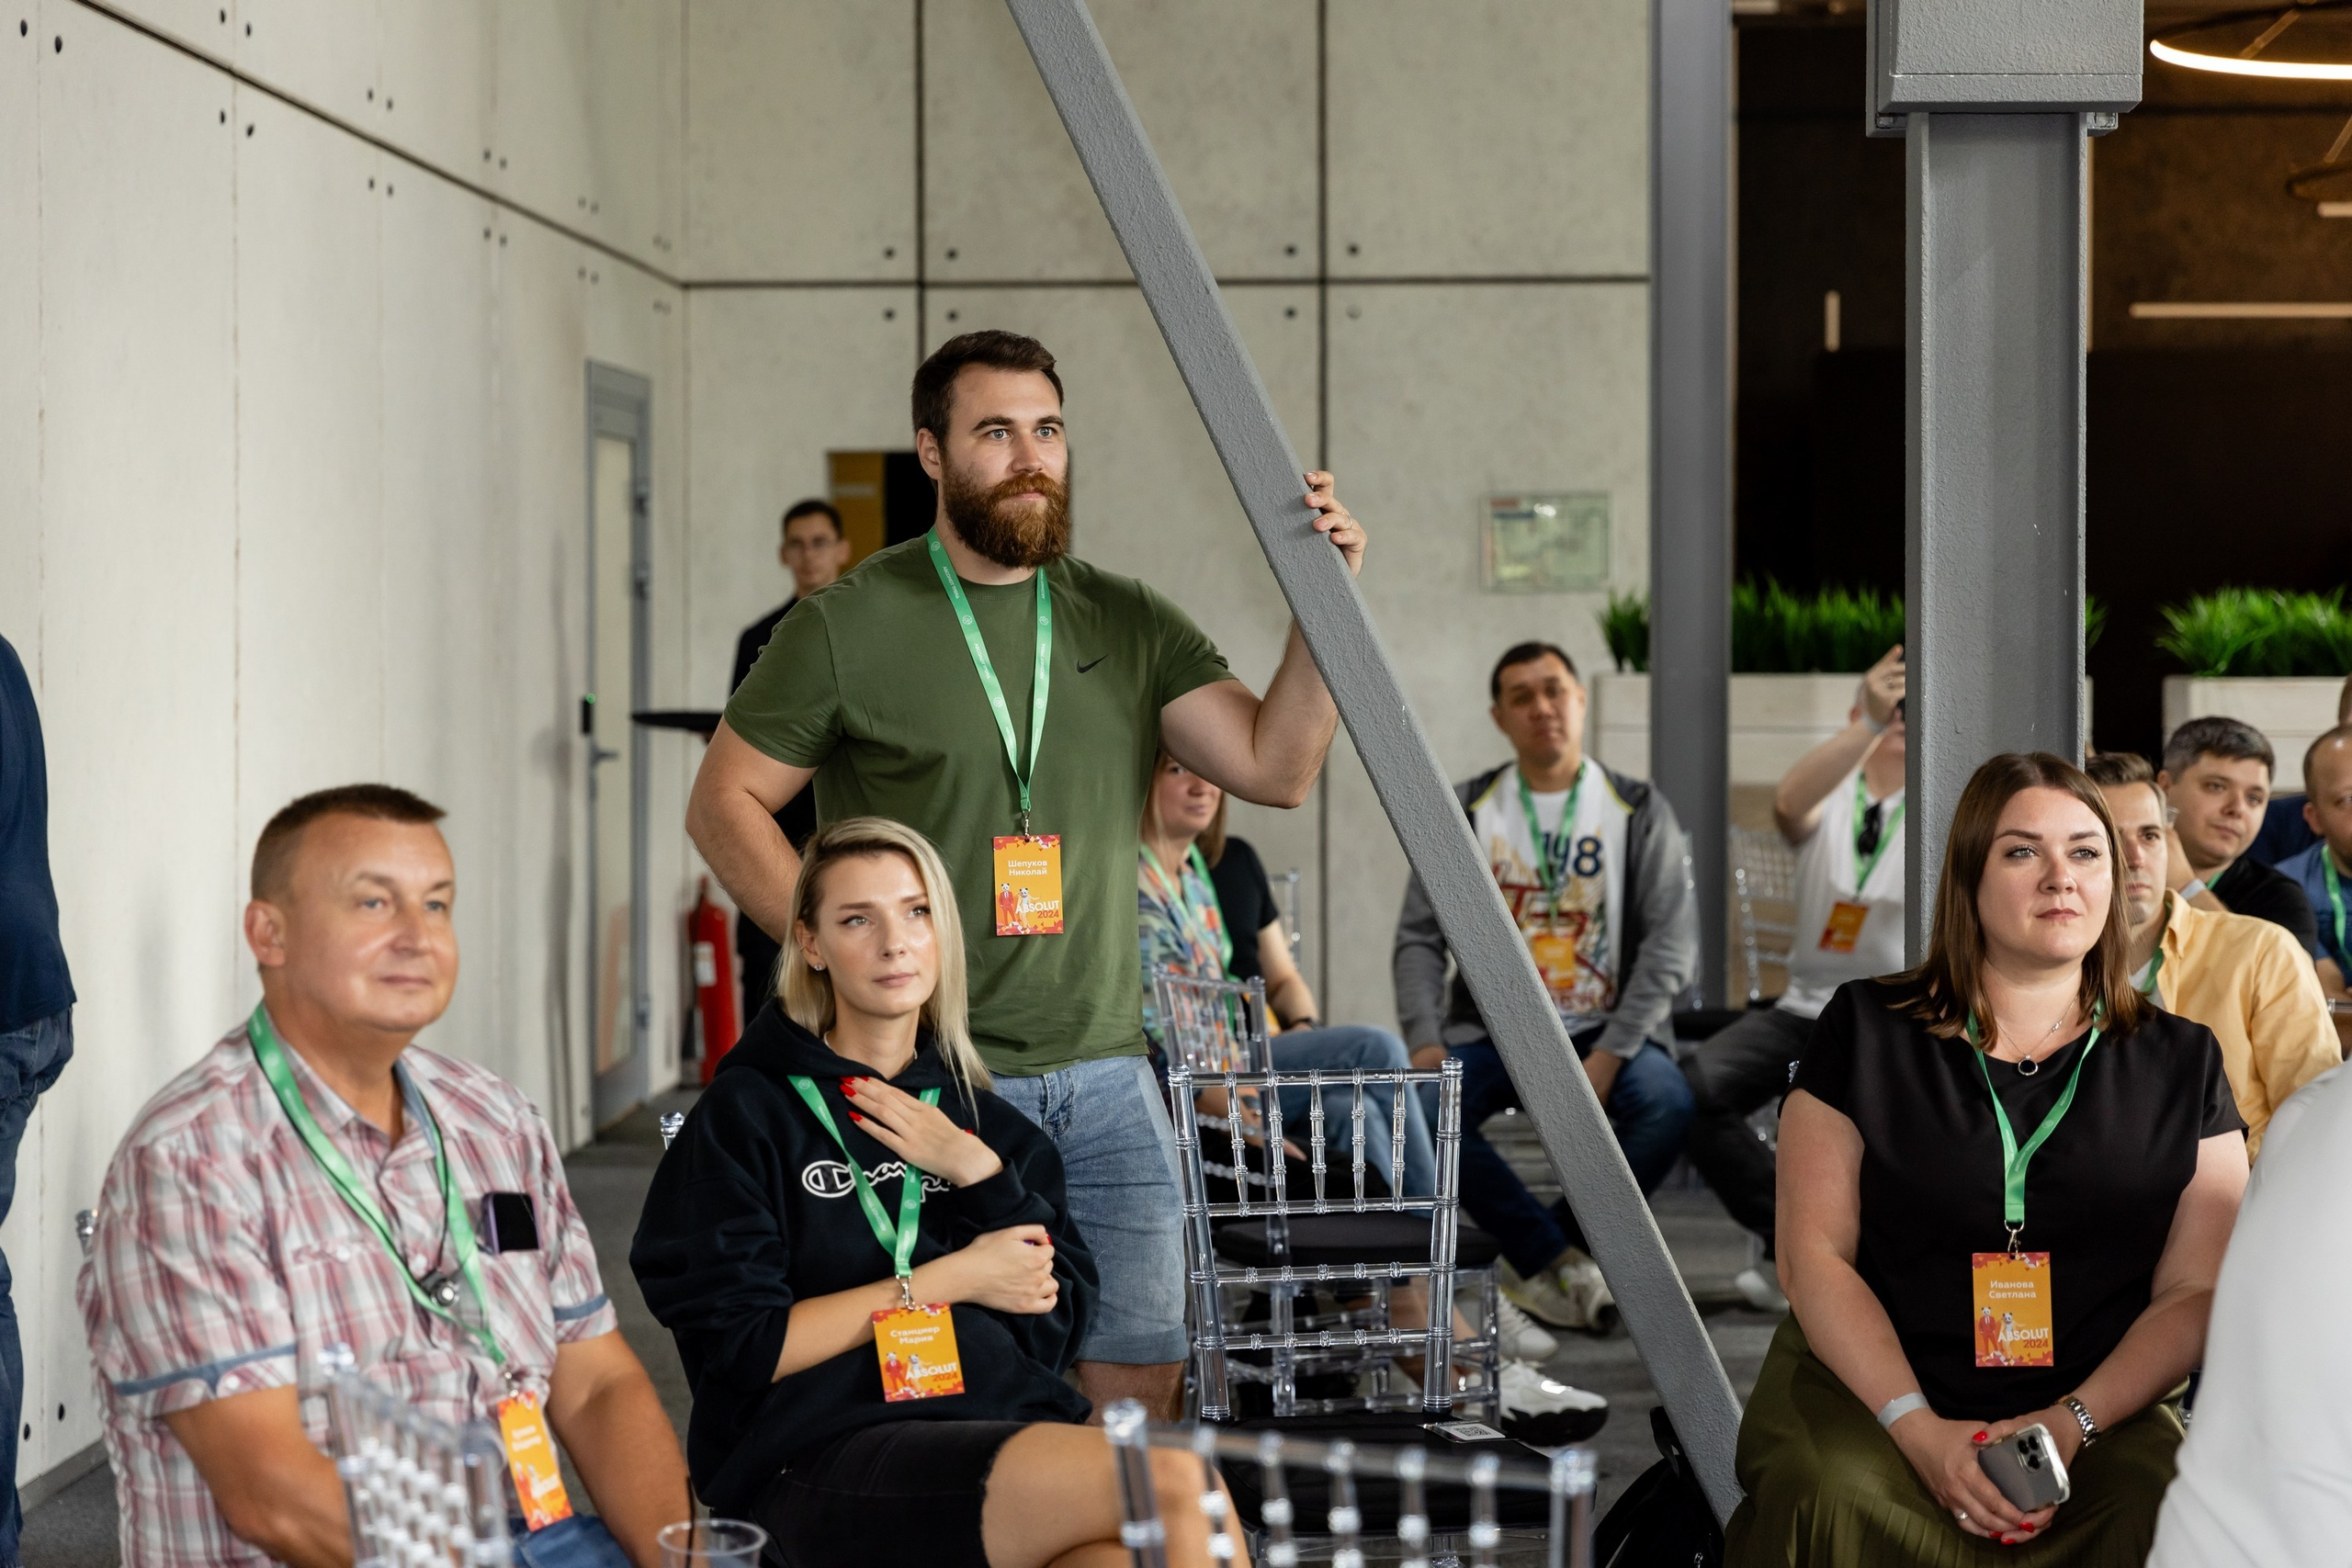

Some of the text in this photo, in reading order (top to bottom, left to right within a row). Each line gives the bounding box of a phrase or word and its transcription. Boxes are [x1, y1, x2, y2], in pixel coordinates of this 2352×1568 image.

[1008, 860, 1047, 868] Шепуков
[1009, 868, 1047, 876] Николай
[1015, 900, 1059, 914] ABSOLUT
[1037, 910, 1059, 919] 2024
[1990, 1280, 2034, 1289] Иванова
[1989, 1291, 2037, 1299] Светлана
[1997, 1327, 2049, 1343] ABSOLUT
[2023, 1339, 2049, 1348] 2024
[906, 1362, 957, 1380] ABSOLUT
